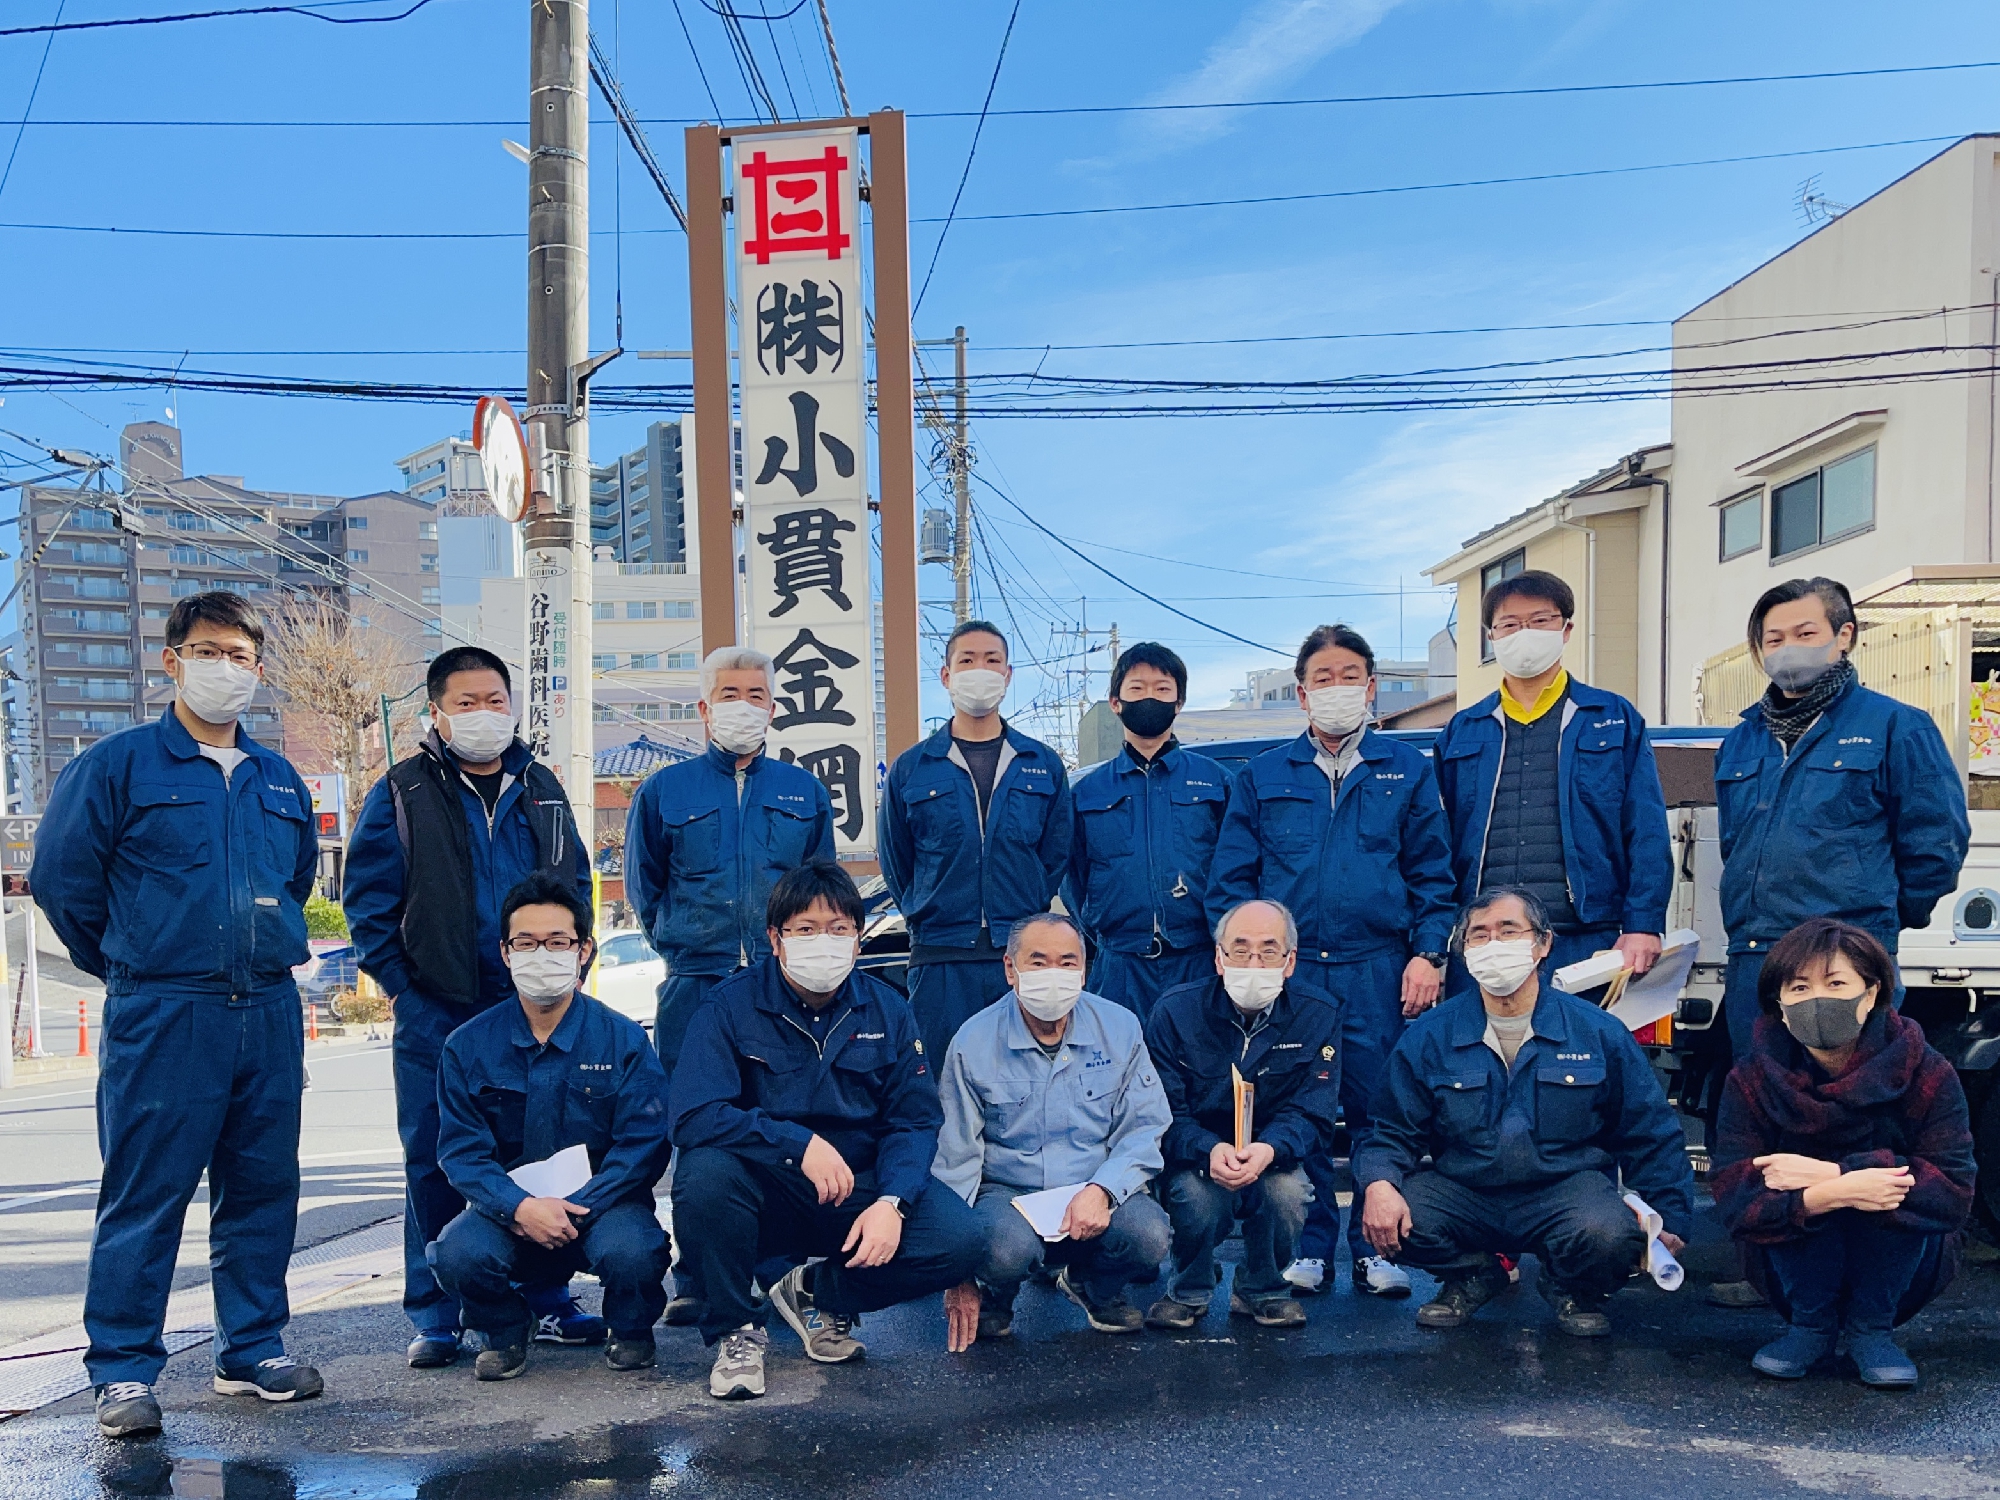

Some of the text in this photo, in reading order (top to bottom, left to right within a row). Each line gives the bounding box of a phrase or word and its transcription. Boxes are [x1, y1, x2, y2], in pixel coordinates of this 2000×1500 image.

[553, 611, 567, 668] 受付随時
[530, 592, 550, 757] 谷野歯科医院
[554, 693, 566, 718] あり
[23, 820, 38, 841] P
[320, 813, 337, 835] P
[13, 850, 31, 863] IN
